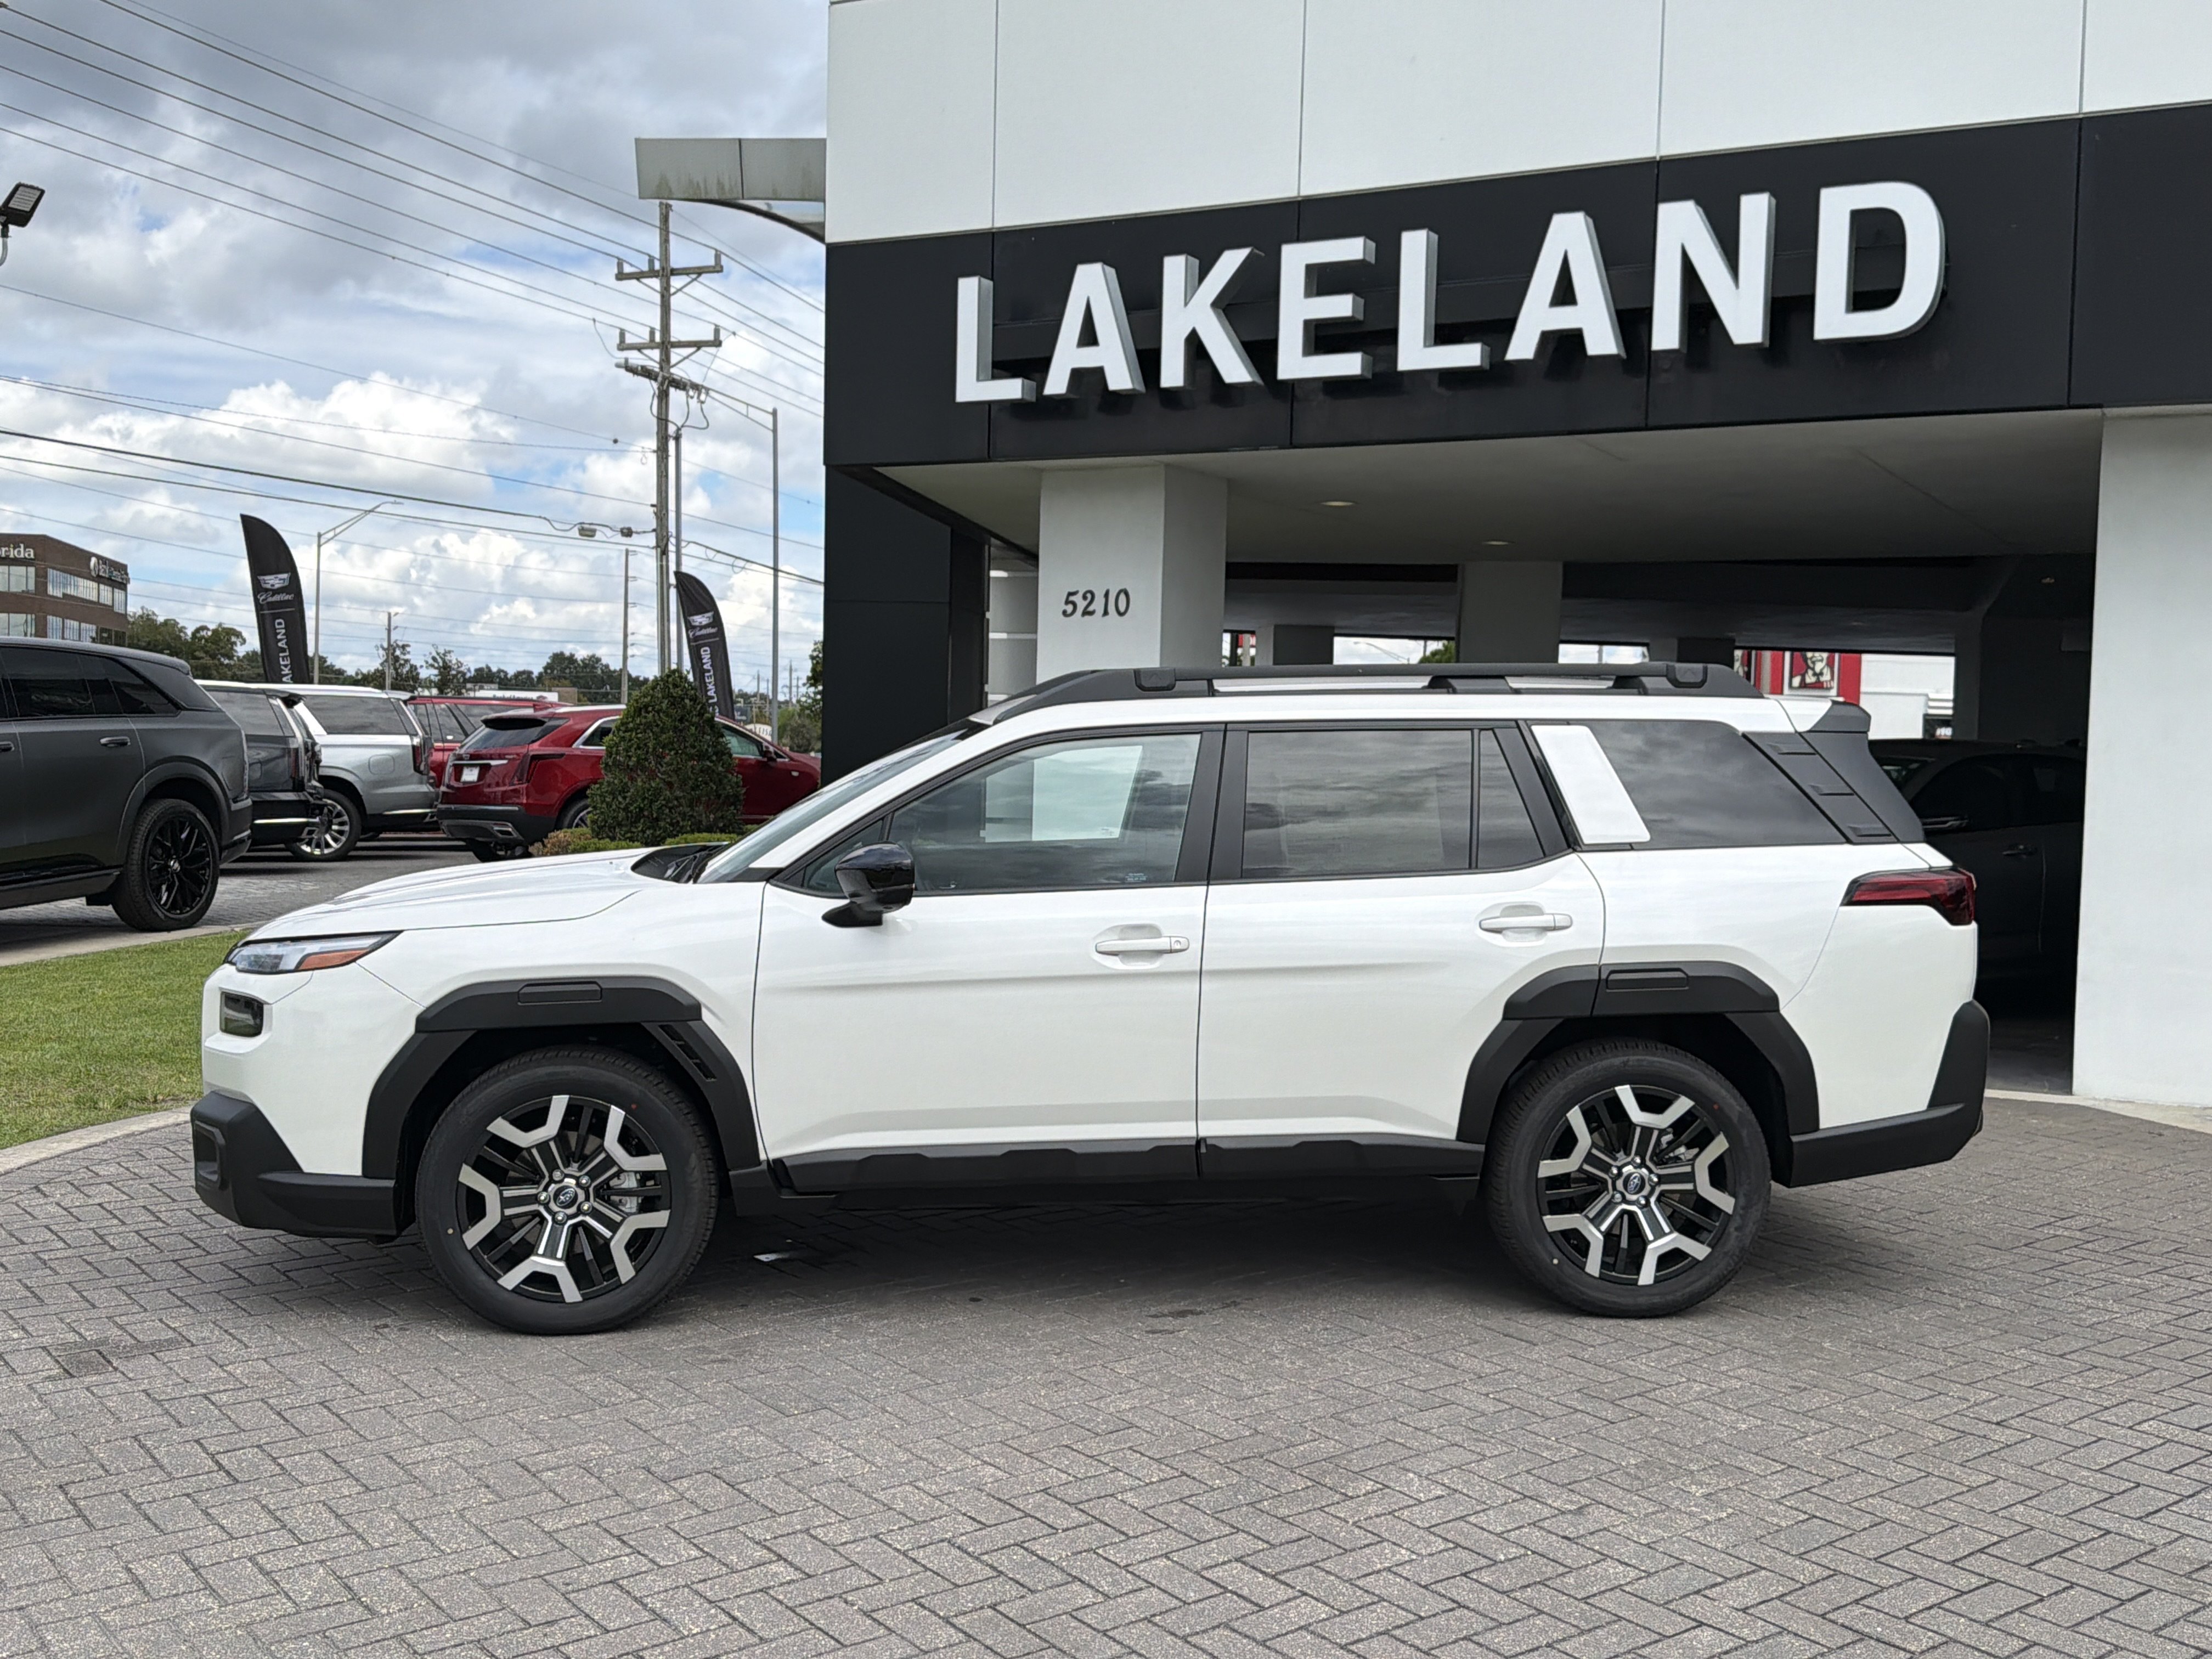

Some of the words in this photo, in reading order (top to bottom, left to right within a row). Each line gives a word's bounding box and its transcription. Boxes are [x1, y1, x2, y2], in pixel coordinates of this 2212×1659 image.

[955, 180, 1945, 403] LAKELAND
[0, 543, 35, 558] rida
[1062, 587, 1131, 618] 5210
[275, 618, 294, 684] AKELAND
[700, 646, 718, 704] LAKELAND
